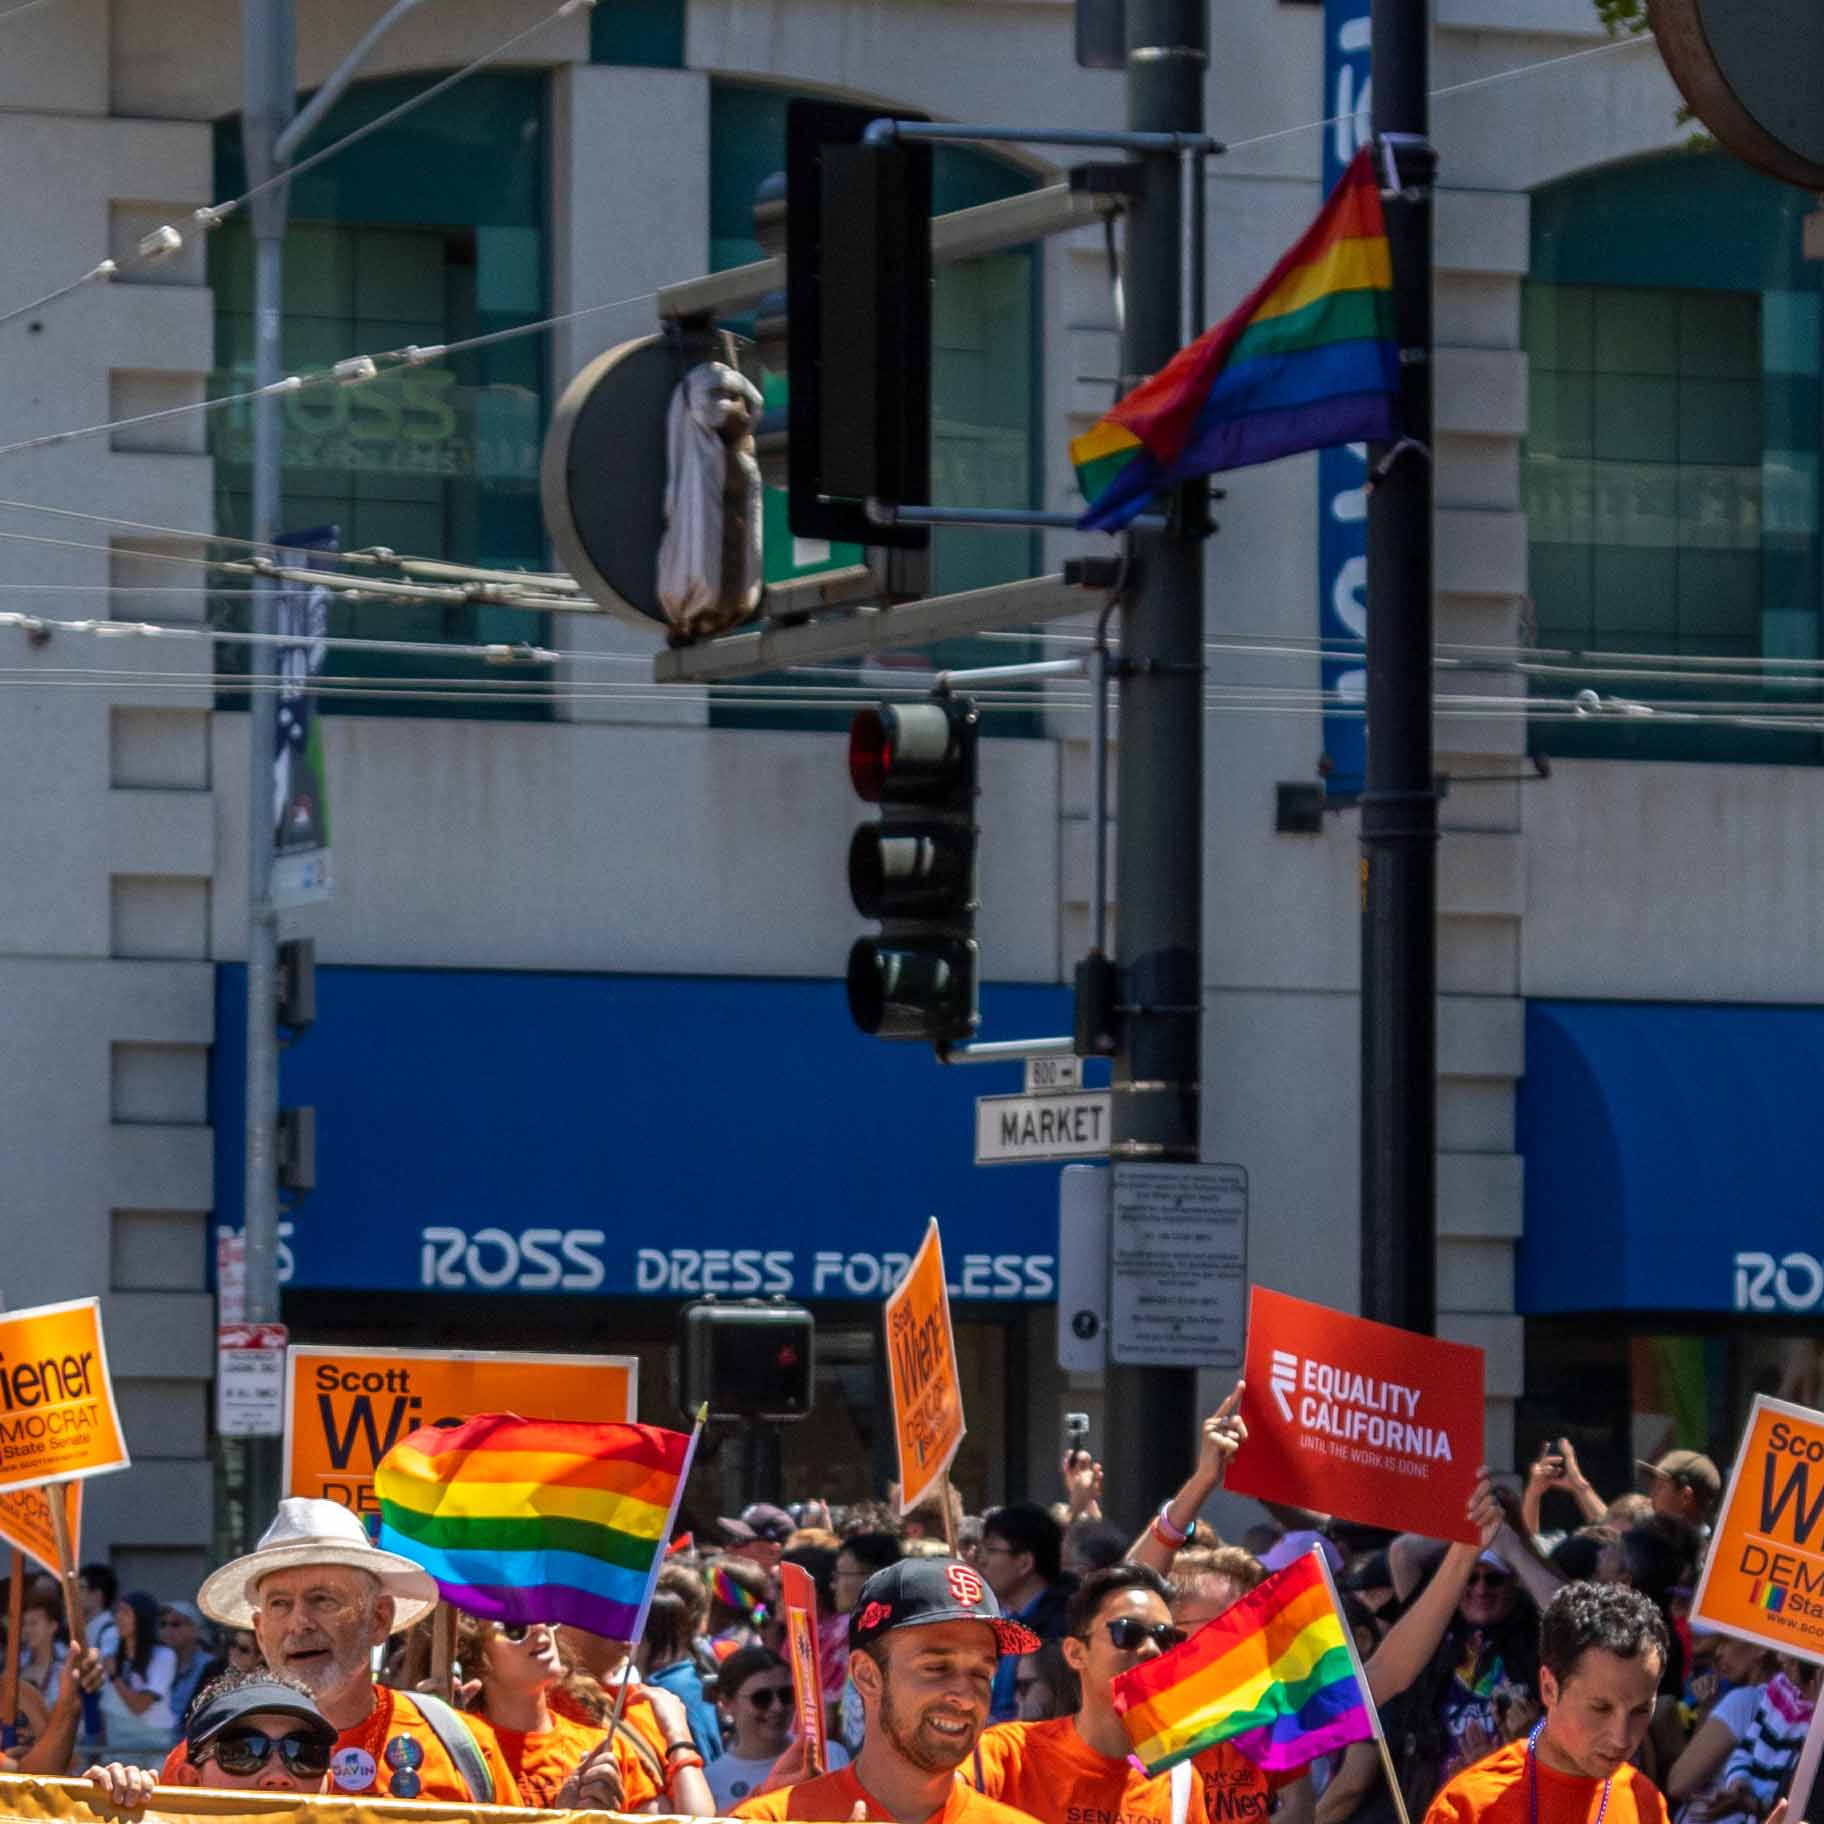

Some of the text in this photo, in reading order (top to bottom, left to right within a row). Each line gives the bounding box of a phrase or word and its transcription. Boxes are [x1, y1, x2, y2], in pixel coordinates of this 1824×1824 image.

[1001, 1104, 1104, 1146] MARKET
[421, 1226, 606, 1289] ROSS
[637, 1248, 794, 1293] DRESS
[315, 1364, 411, 1394] Scott
[1303, 1359, 1422, 1418] EQUALITY
[3, 1440, 46, 1460] State
[1299, 1396, 1453, 1463] CALIFORNIA
[1299, 1433, 1430, 1478] UNTIL THE WORK IS DONE
[332, 1765, 374, 1777] GAVIN
